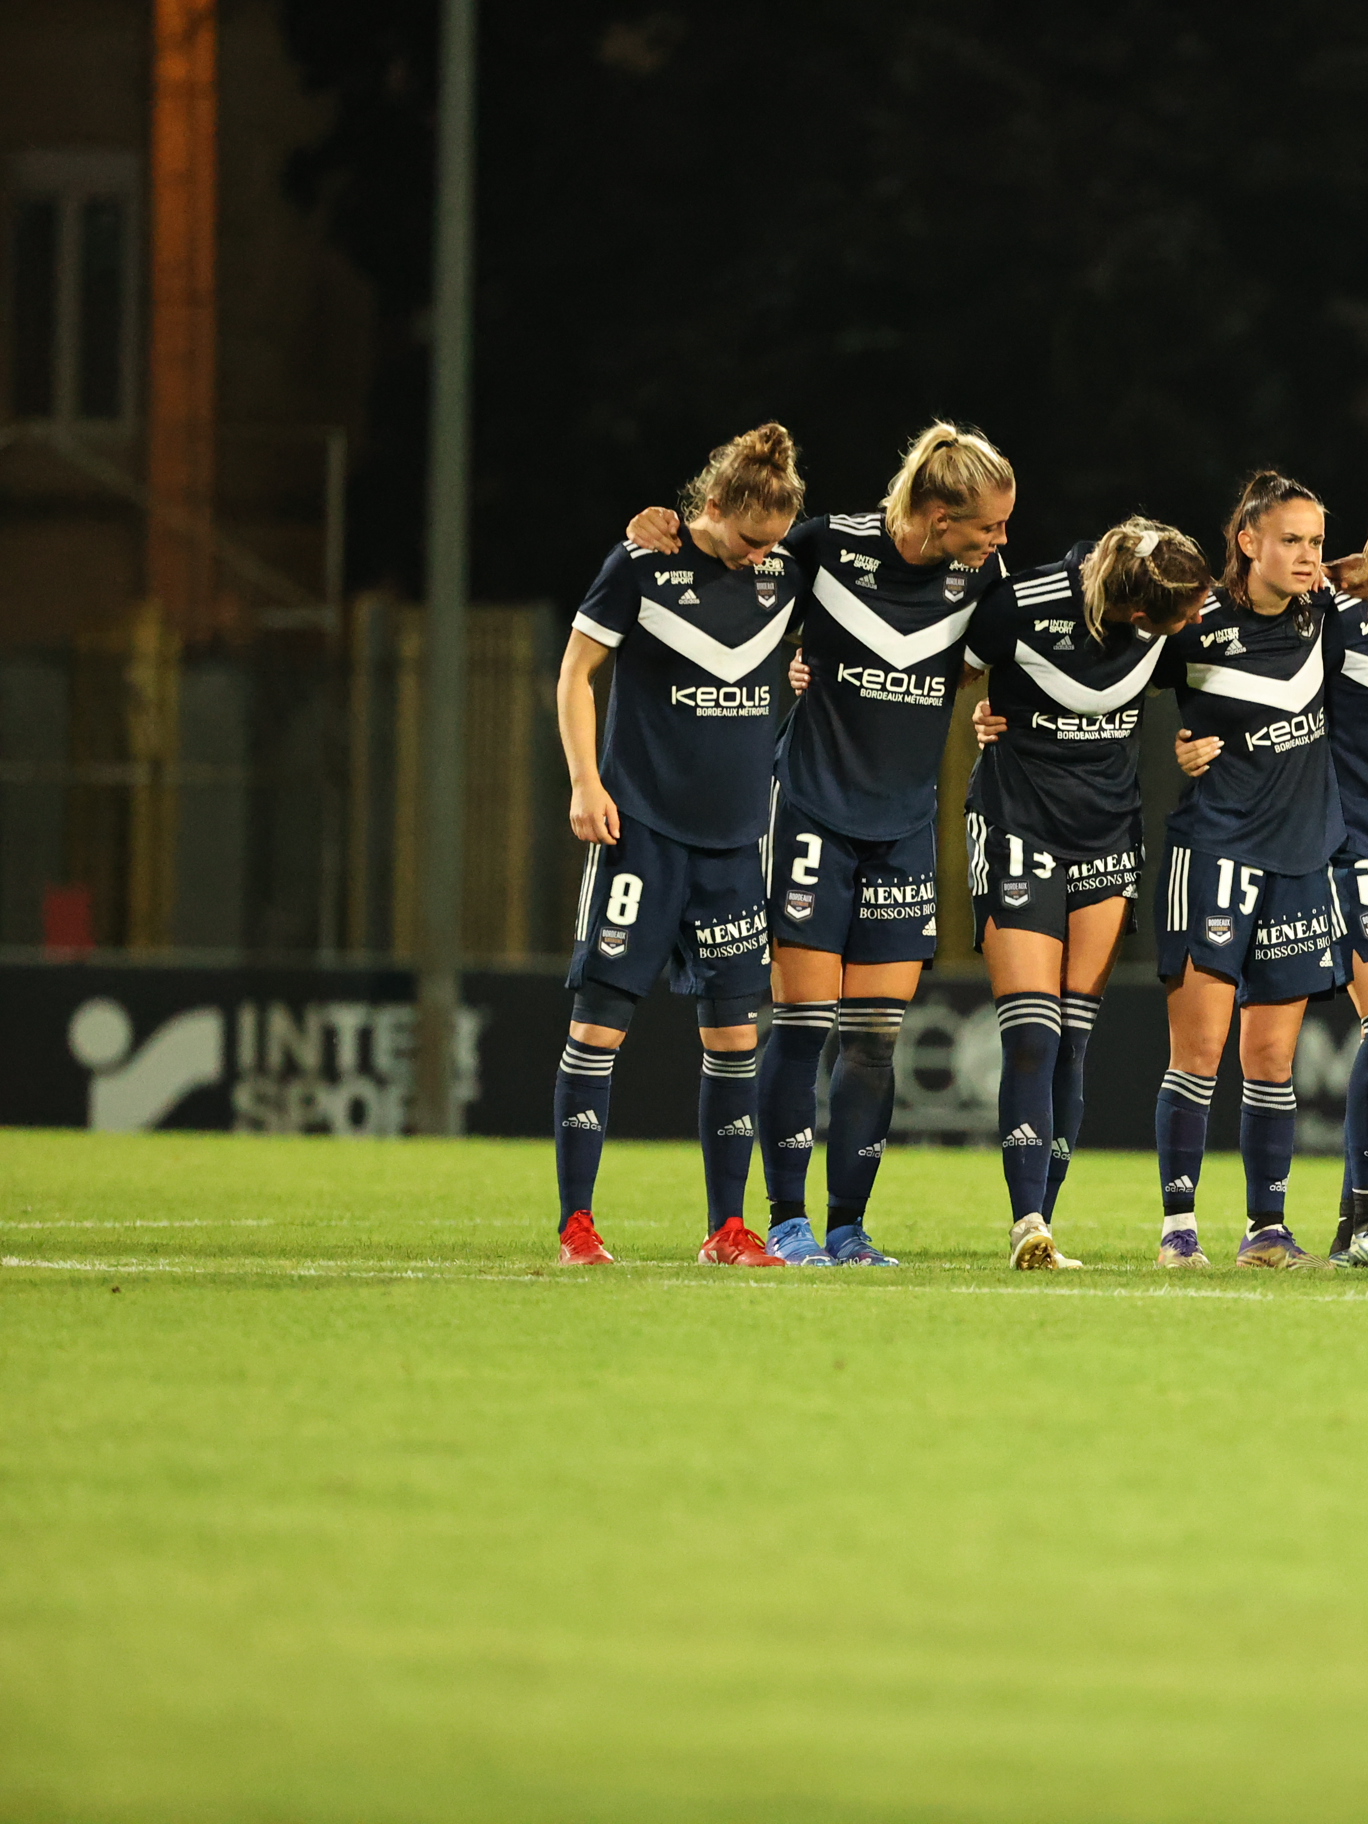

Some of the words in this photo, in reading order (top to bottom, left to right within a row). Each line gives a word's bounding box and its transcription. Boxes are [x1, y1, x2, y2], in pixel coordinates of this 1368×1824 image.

[854, 561, 878, 573] SPORT
[856, 554, 881, 567] INTER
[1050, 619, 1076, 628] INTER
[1215, 627, 1239, 638] INTER
[860, 688, 903, 702] BORDEAUX
[904, 693, 943, 707] MÉTROPOLE
[696, 707, 738, 716] BORDEAUX
[739, 706, 769, 716] MÉTROPOLE
[1057, 730, 1100, 740] BORDEAUX
[791, 832, 823, 886] 2
[861, 881, 935, 905] MENEAU
[1216, 857, 1264, 916] 15
[606, 873, 644, 926] 8
[859, 905, 921, 920] BOISSONS
[922, 902, 936, 916] BIO
[696, 909, 768, 945] MENEAU
[1255, 914, 1329, 945] MENEAU
[699, 938, 758, 959] BOISSONS
[1255, 941, 1315, 961] BOISSONS
[1317, 935, 1331, 951] BIO
[562, 1119, 602, 1132] adidas
[717, 1126, 755, 1137] adidas
[778, 1138, 814, 1149] adidas
[1002, 1137, 1043, 1148] adidas
